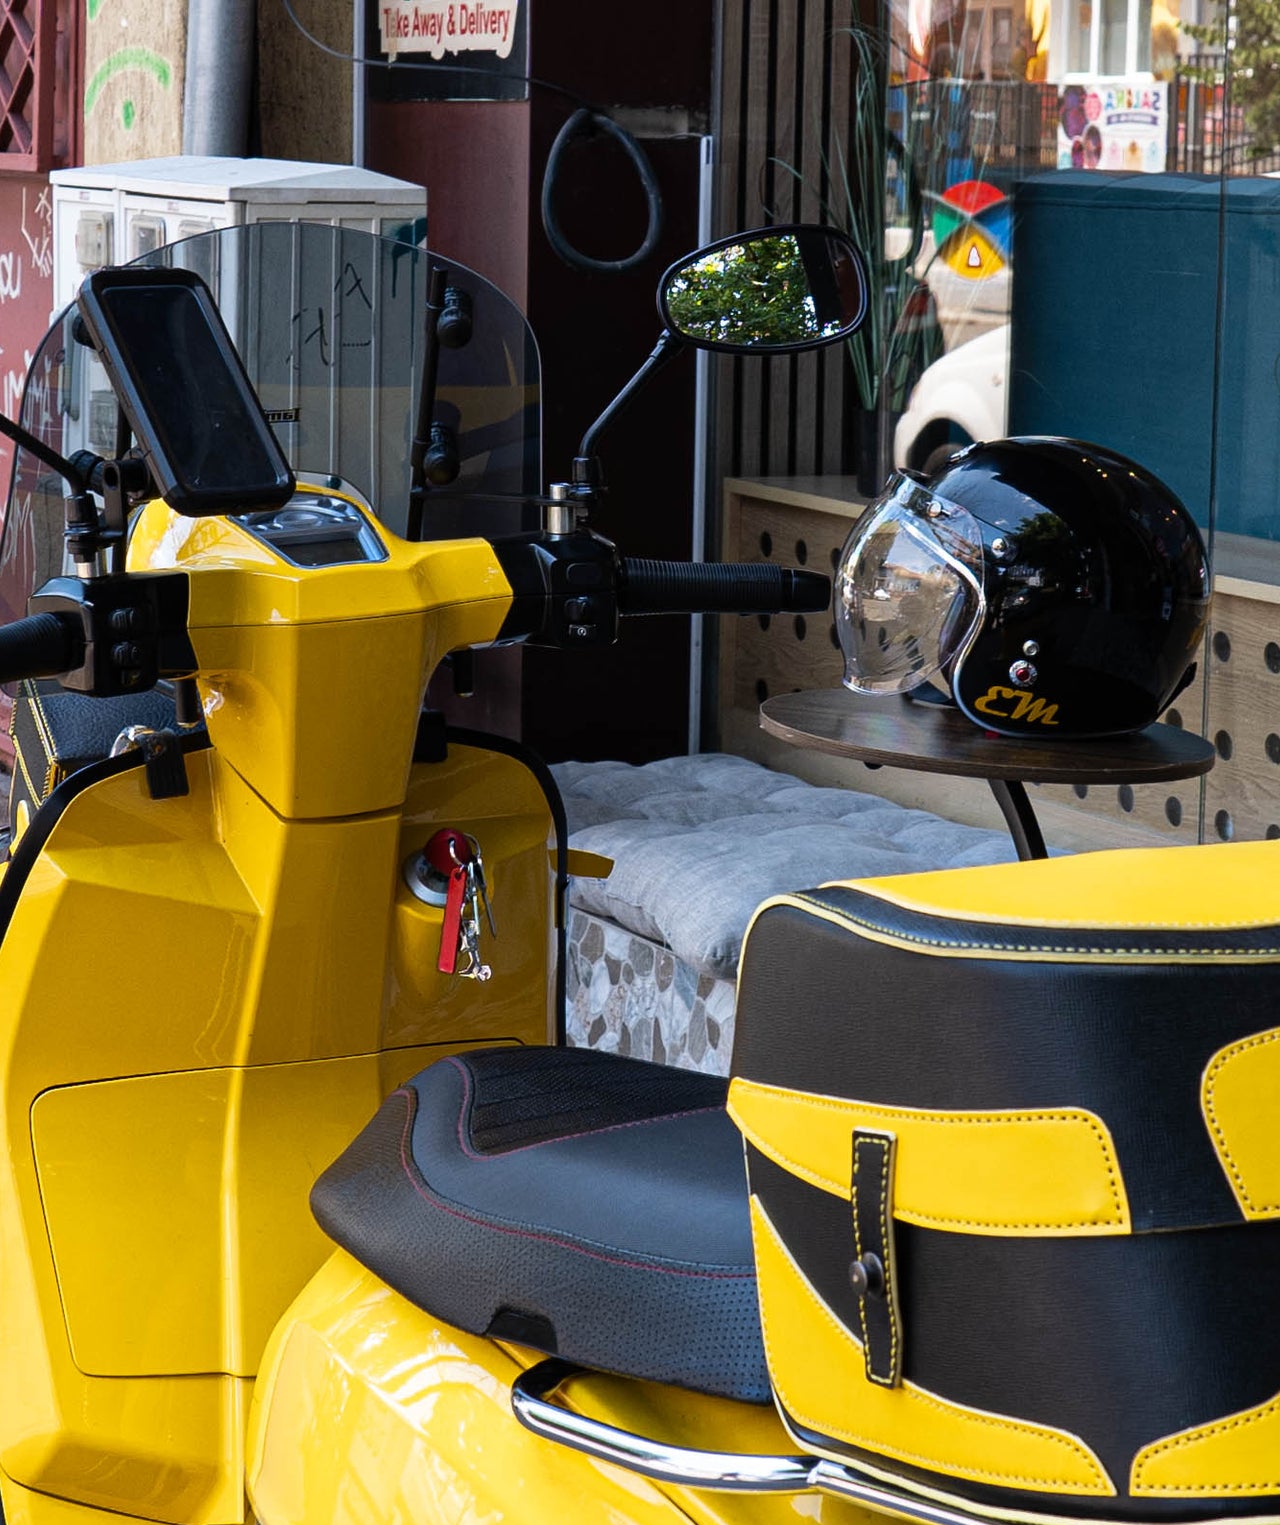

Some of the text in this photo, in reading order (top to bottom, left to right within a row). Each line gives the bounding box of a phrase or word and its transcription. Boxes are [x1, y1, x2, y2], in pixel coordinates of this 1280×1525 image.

[412, 7, 444, 44] Away
[446, 4, 457, 36] &
[459, 3, 511, 43] Delivery
